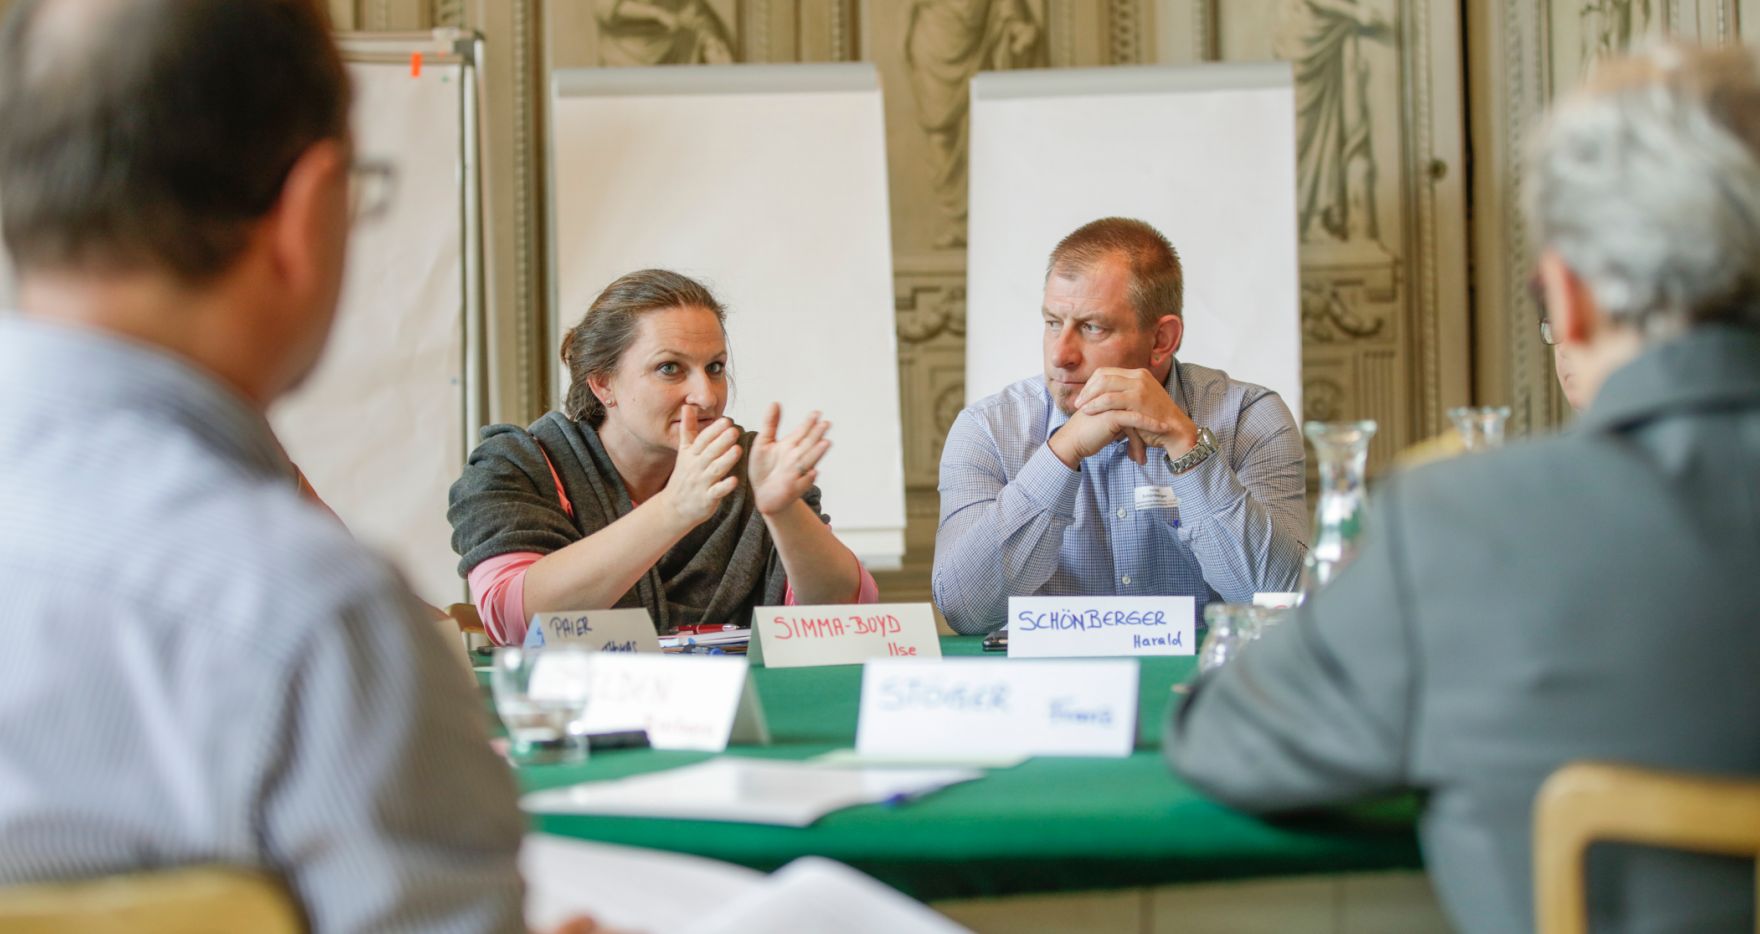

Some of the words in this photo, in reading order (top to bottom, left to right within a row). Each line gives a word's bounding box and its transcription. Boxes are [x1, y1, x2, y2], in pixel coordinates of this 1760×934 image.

[549, 616, 592, 637] PAIER
[773, 615, 902, 640] SIMMA-BOYD
[1017, 608, 1168, 632] SCHÖNBERGER
[888, 642, 917, 657] Ilse
[1133, 631, 1182, 649] Harald
